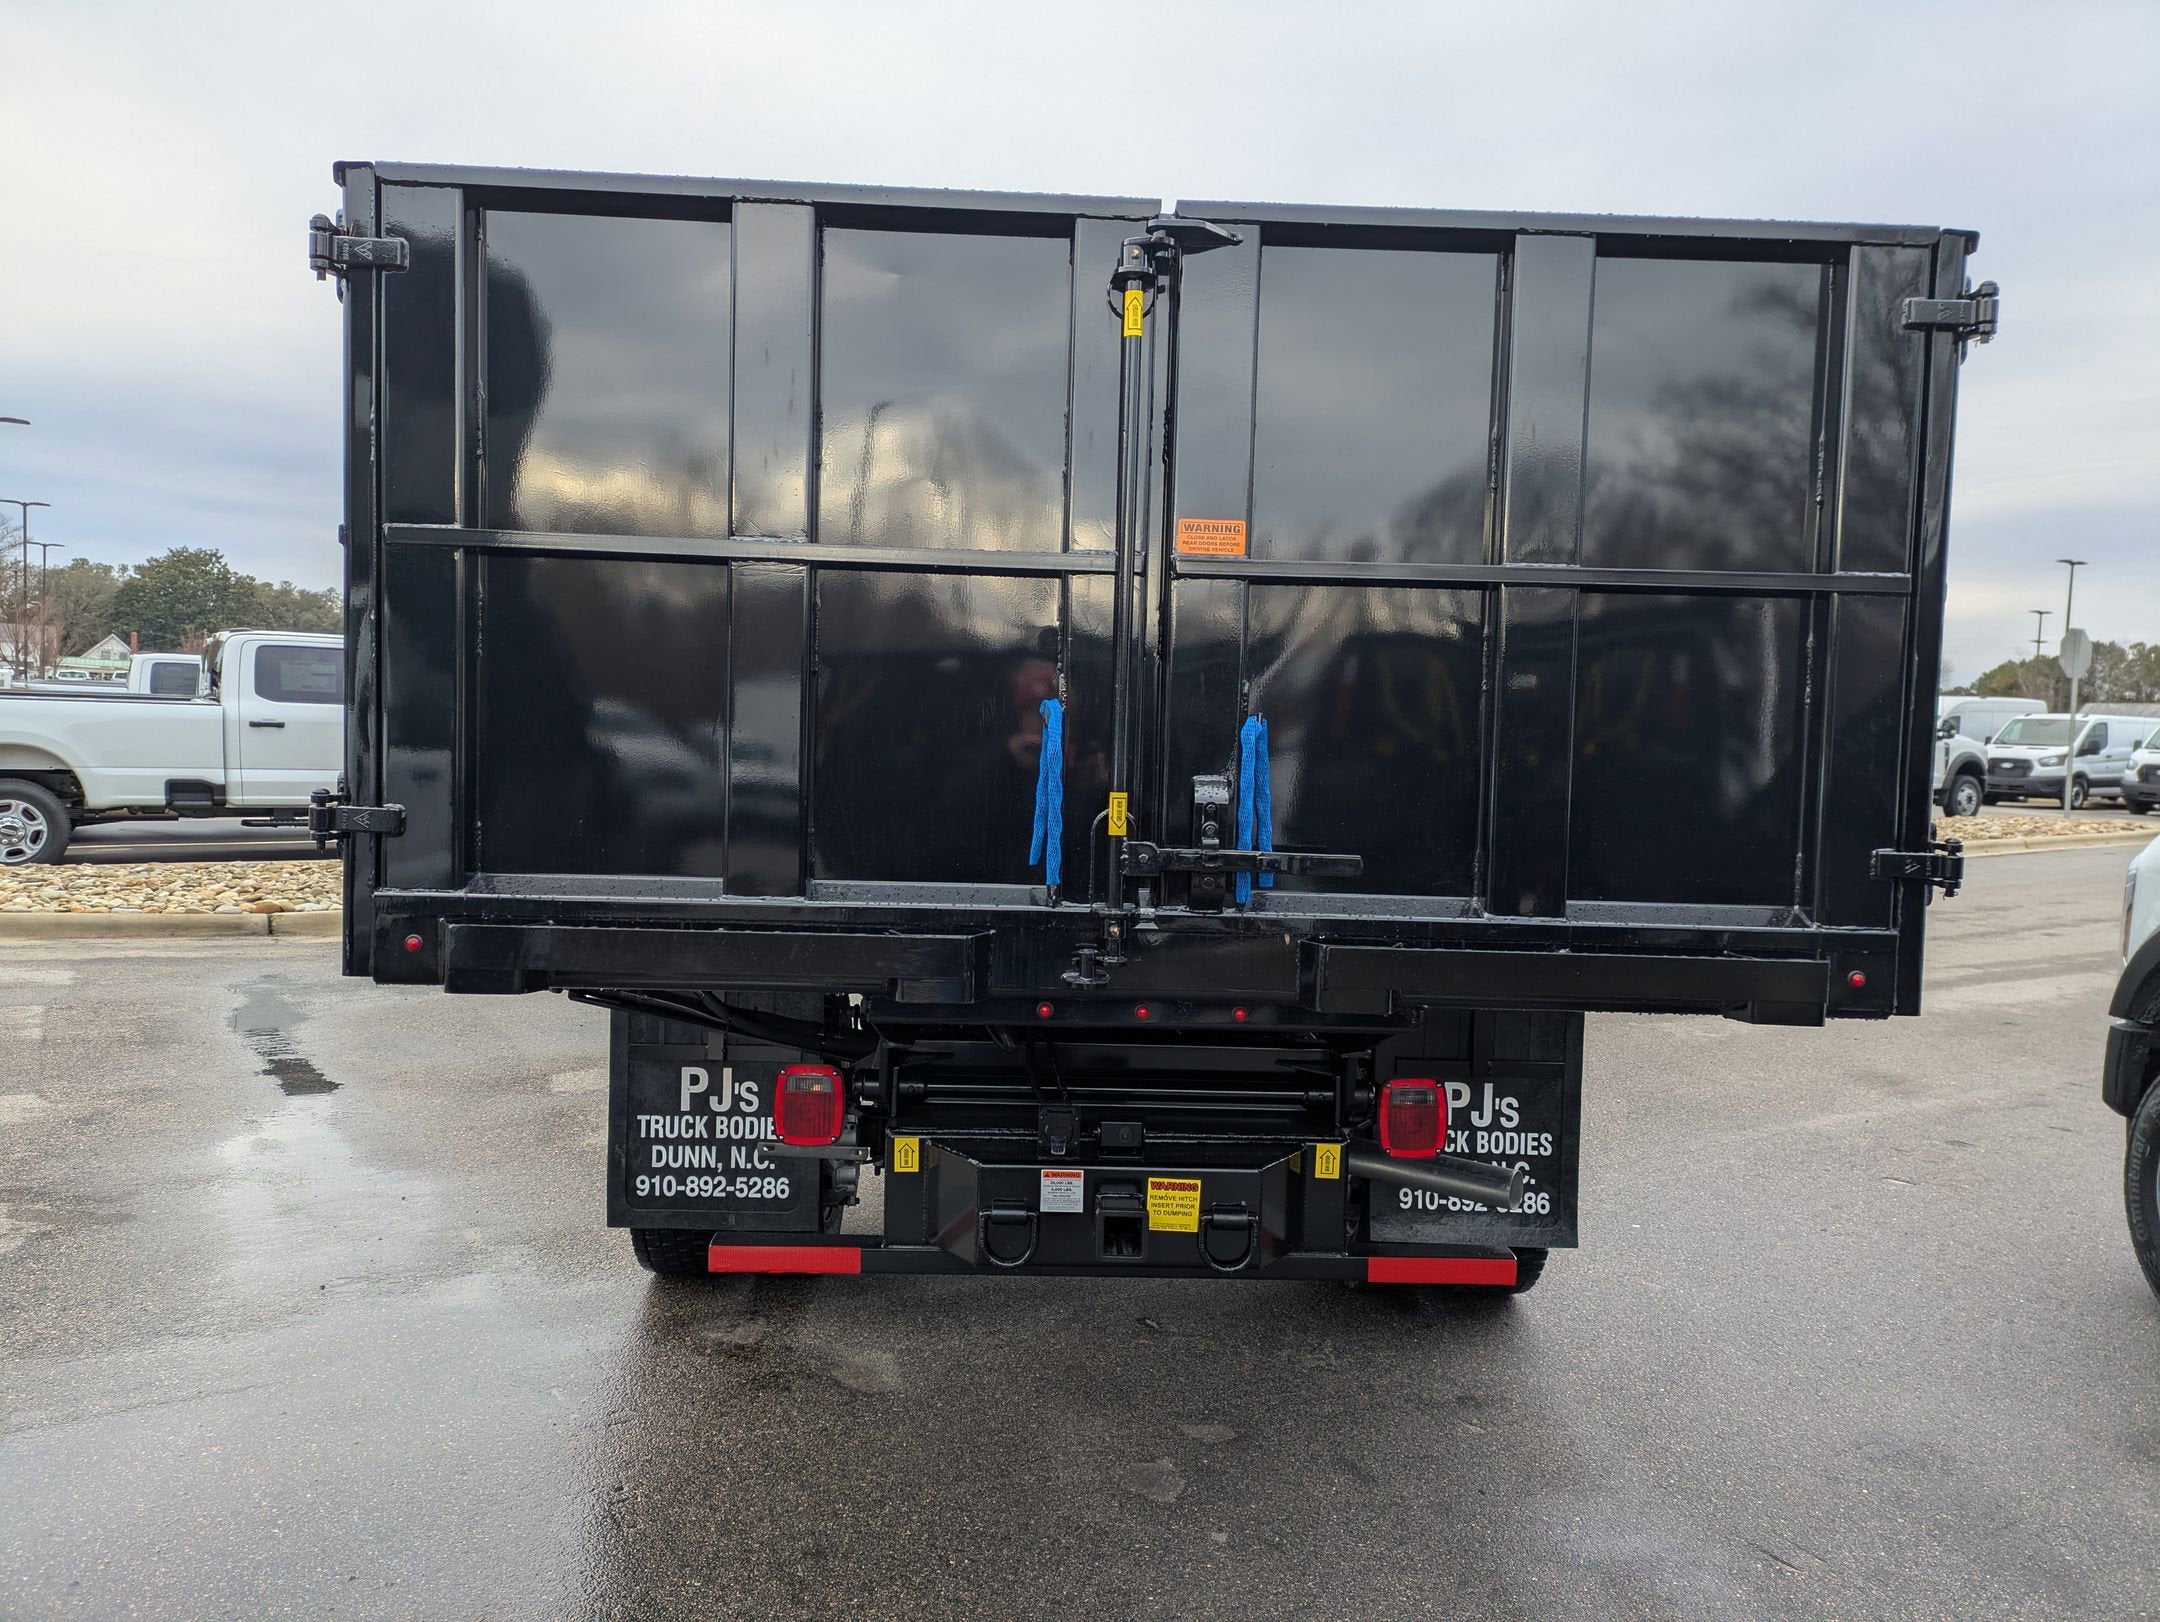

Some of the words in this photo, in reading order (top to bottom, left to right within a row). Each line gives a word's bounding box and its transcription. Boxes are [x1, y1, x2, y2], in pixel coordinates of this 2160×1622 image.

[1184, 523, 1241, 533] WARNING
[680, 1066, 760, 1112] PJ's
[636, 1114, 709, 1139] TRUCK
[715, 1115, 778, 1140] BODIE
[1476, 1131, 1553, 1156] BODIES
[651, 1144, 723, 1173] DUNN,
[635, 1175, 790, 1199] 910-892-5286
[1150, 1181, 1199, 1192] WARNING
